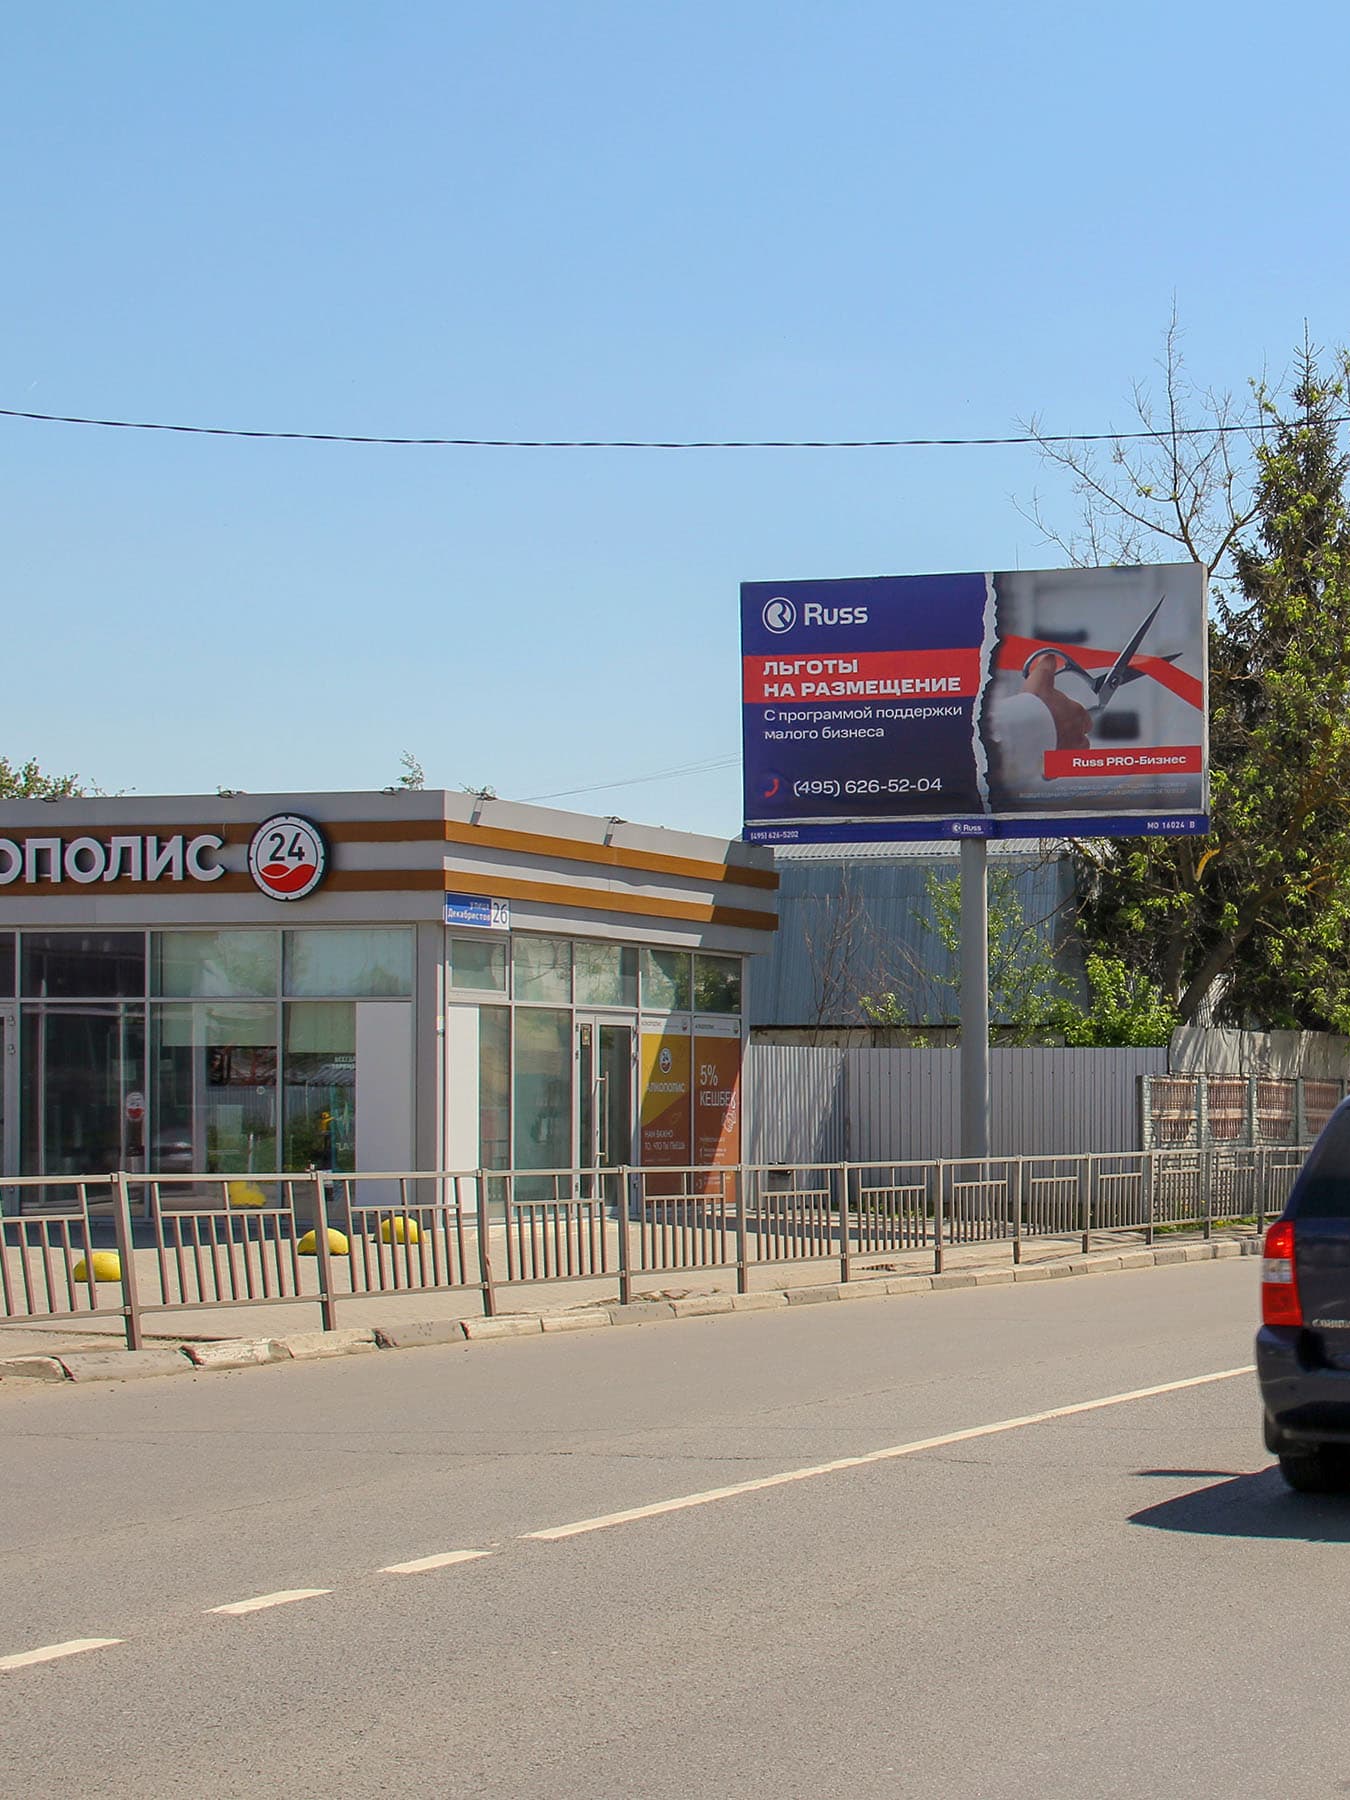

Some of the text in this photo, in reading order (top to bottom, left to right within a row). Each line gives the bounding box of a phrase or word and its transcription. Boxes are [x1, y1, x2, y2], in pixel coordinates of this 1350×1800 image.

[804, 603, 869, 626] Russ
[763, 659, 859, 676] ЛЬГОТЫ
[764, 677, 961, 697] НА РАЗМЕЩЕНИЕ
[764, 705, 963, 724] С программой поддержки
[764, 727, 885, 740] малого бизнеса
[1072, 755, 1187, 768] Russ PRO-Бизнес
[793, 778, 943, 798] (495) 626-52-04
[963, 824, 982, 832] Russ
[1162, 821, 1185, 829] 16024
[269, 832, 305, 862] 24
[493, 902, 508, 924] 26
[700, 1064, 719, 1086] 5%
